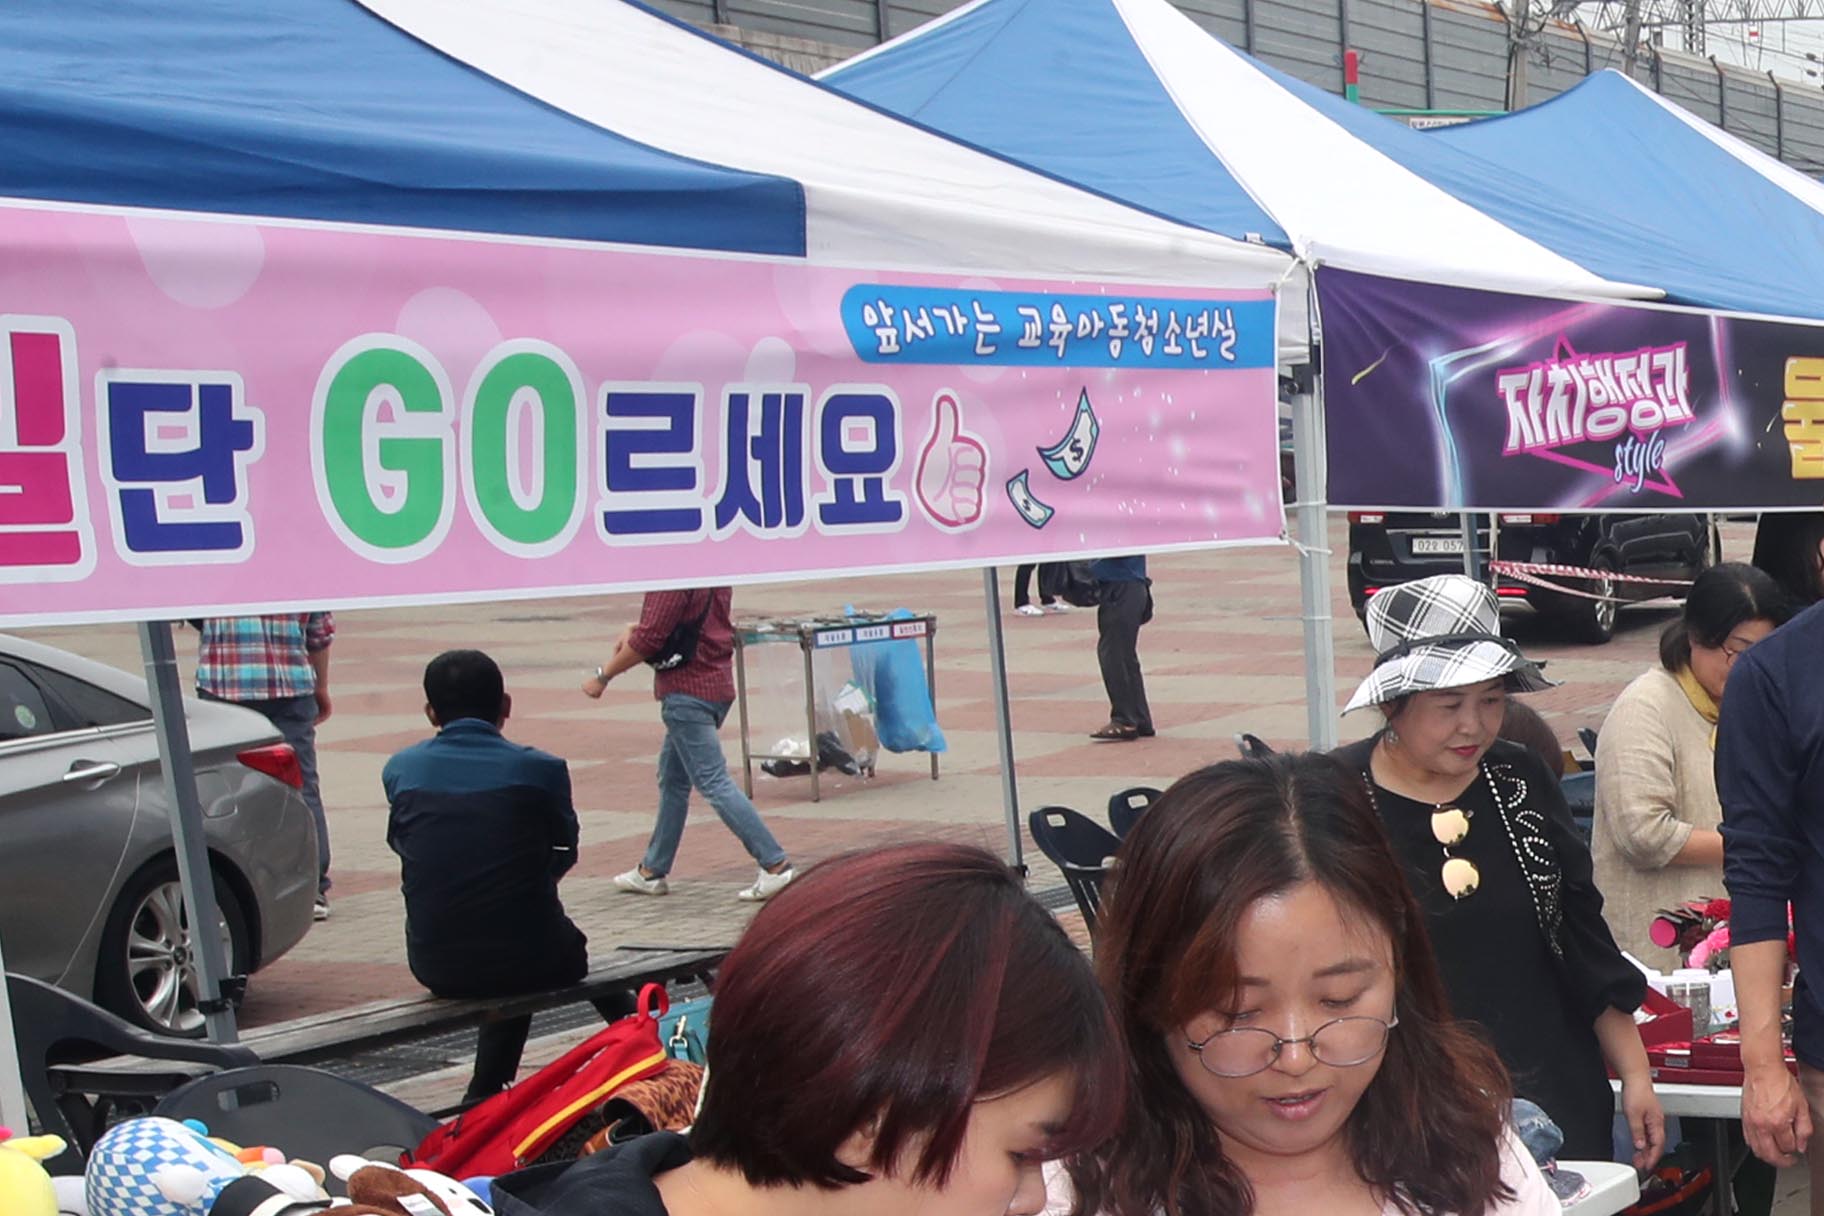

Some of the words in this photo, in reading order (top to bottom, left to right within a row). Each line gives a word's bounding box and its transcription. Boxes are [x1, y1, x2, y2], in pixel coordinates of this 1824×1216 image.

[861, 300, 1002, 356] 앞서가는
[1015, 302, 1240, 362] 교육아동청소년실
[1497, 345, 1696, 451] 자치행정과
[316, 342, 905, 554] GO르세요
[1613, 430, 1665, 493] style
